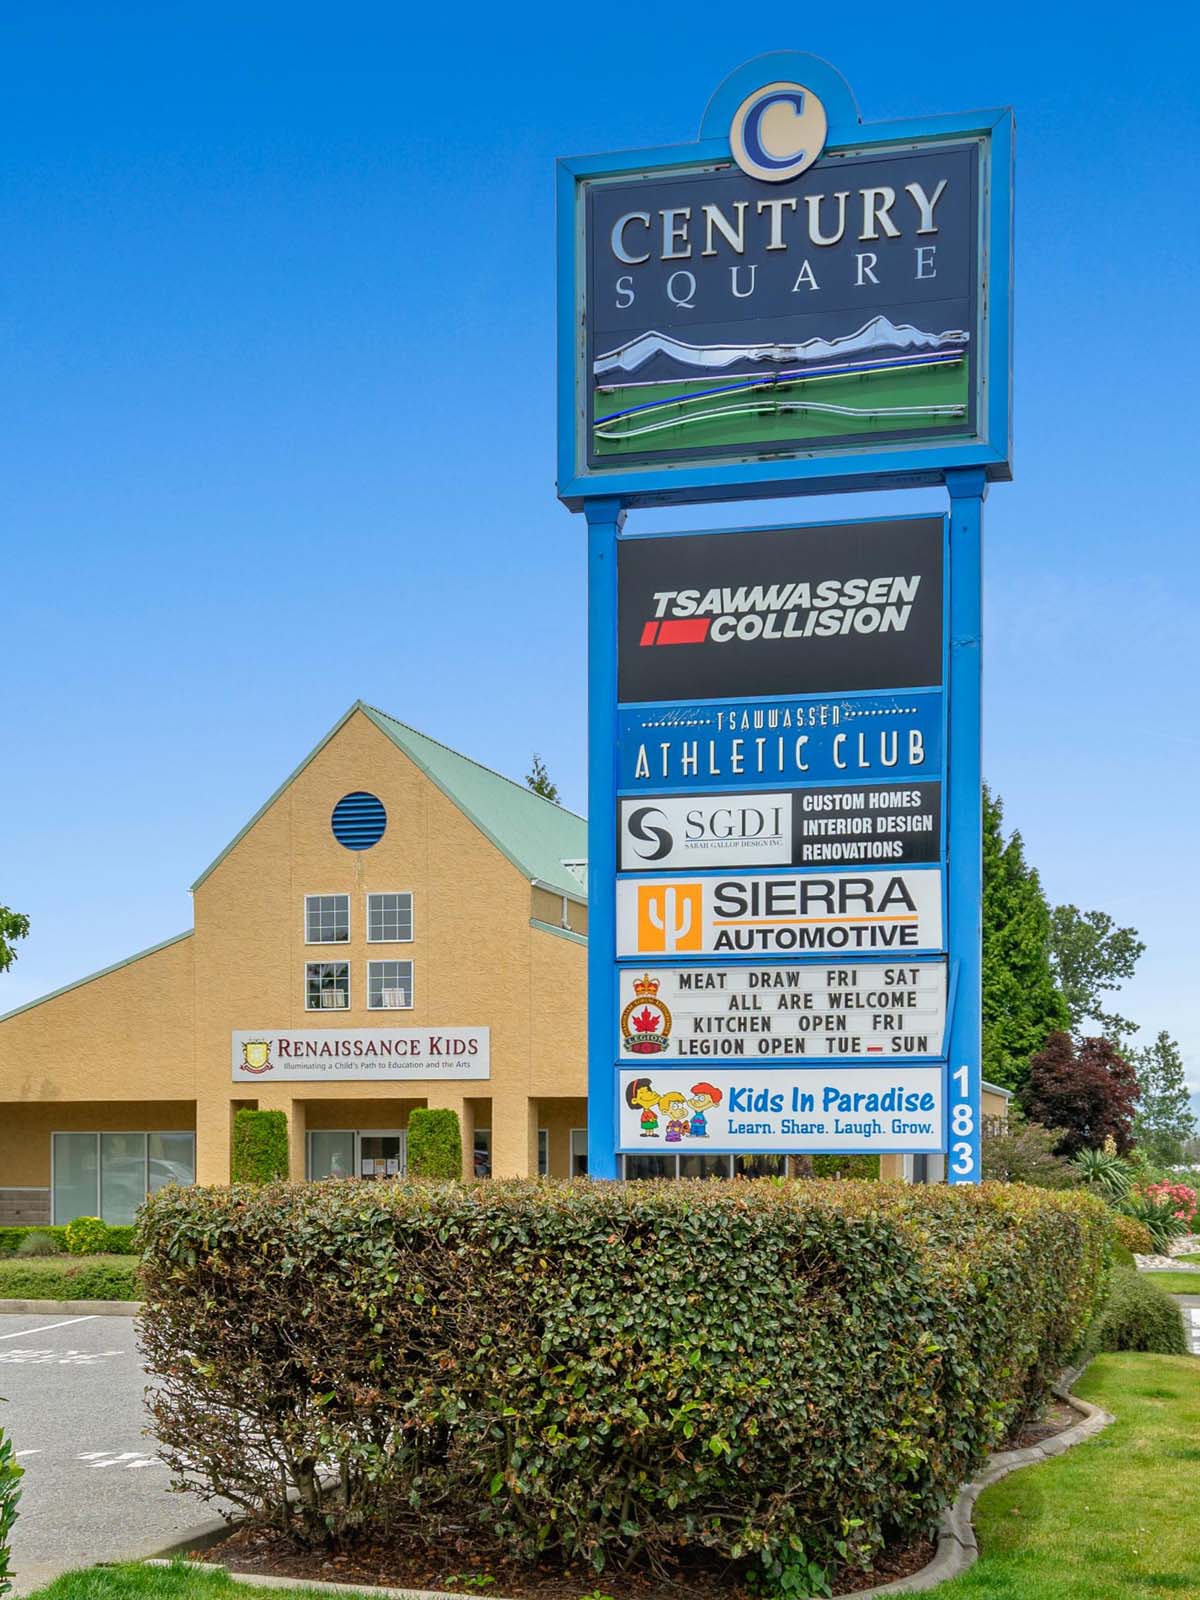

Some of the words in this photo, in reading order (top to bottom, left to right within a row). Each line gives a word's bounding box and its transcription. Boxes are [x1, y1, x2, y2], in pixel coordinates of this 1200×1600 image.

[743, 90, 805, 171] C
[611, 180, 948, 264] CENTURY
[615, 247, 937, 309] SQUARE
[653, 576, 921, 618] TSAWWASSEN
[710, 605, 912, 643] COLLISION
[716, 706, 840, 731] TSAWWASSEN
[635, 735, 809, 779] ATHLETIC
[833, 730, 926, 770] CLUB
[803, 793, 865, 812] CUSTOM
[868, 790, 922, 809] HOMES
[685, 807, 783, 839] SGDI
[803, 817, 872, 836] INTERIOR
[876, 815, 933, 832] DESIGN
[741, 840, 769, 848] DESIGN
[803, 840, 904, 861] RENOVATIONS
[712, 876, 918, 918] SIERRA
[713, 924, 919, 951] AUTOMOTIVE
[679, 972, 727, 990] MEAT
[749, 971, 800, 988] DRAW
[827, 970, 857, 987] FRI
[884, 968, 921, 985] SAT
[728, 994, 762, 1011] ALL
[777, 993, 814, 1010] ARE
[828, 991, 917, 1009] WELCOME
[693, 1015, 772, 1033] KITCHEN
[799, 1014, 847, 1031] OPEN
[873, 1013, 904, 1031] FRI
[278, 1039, 421, 1057] RENAISSANCE
[429, 1036, 479, 1056] KIDS
[678, 1038, 744, 1056] LEGION
[758, 1037, 806, 1054] OPEN
[826, 1036, 861, 1053] TUE
[891, 1035, 928, 1052] SUN
[284, 1062, 326, 1072] Illuminating
[335, 1061, 359, 1070] Child's
[361, 1061, 376, 1070] Path
[378, 1061, 386, 1069] to
[388, 1060, 423, 1069] Education
[426, 1060, 440, 1069] and
[442, 1060, 454, 1069] the
[456, 1060, 471, 1069] Arts
[728, 1087, 784, 1114] Kids
[791, 1087, 817, 1113] In
[822, 1086, 935, 1113] Paradise
[728, 1119, 776, 1135] Learn.
[780, 1119, 829, 1135] Share.
[834, 1118, 886, 1138] Laugh.
[891, 1118, 934, 1134] Grow.
[952, 1065, 974, 1185] 183
